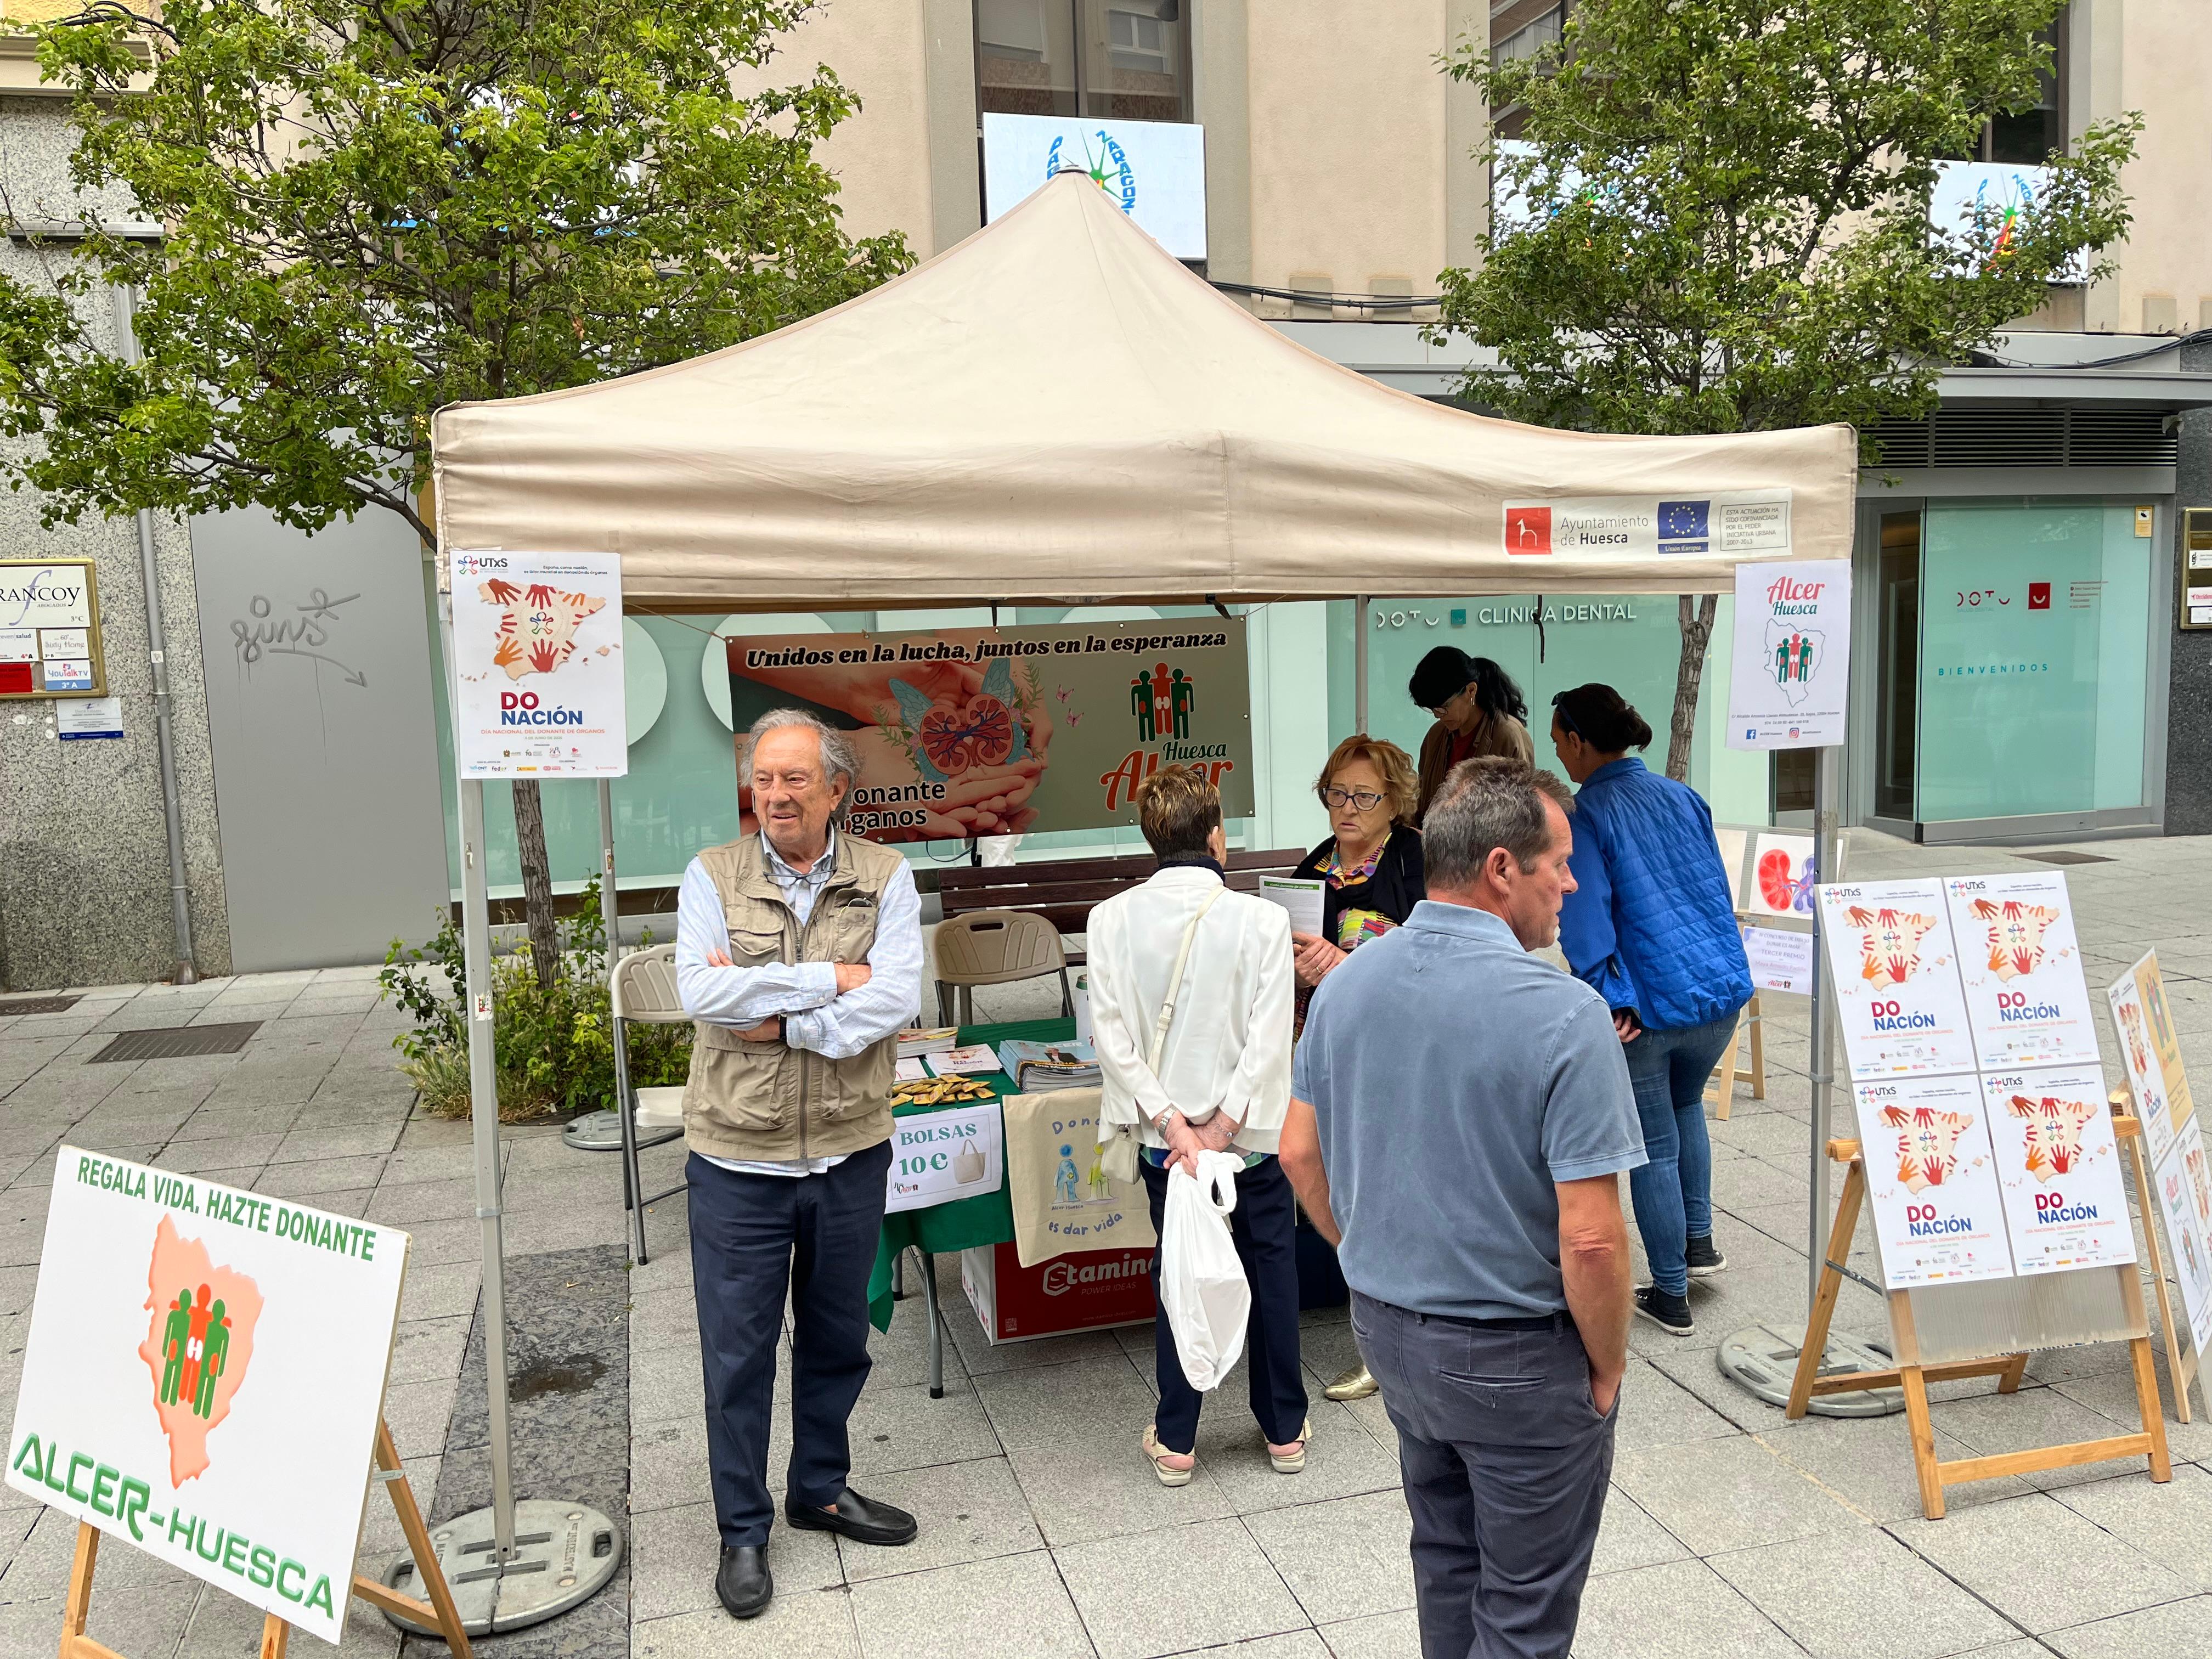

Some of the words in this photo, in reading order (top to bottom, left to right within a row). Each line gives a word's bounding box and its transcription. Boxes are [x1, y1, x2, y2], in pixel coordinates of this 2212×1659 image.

[1096, 129, 1136, 216] ZARAGOZ
[1560, 515, 1649, 533] Ayuntamiento
[1560, 533, 1575, 546] de
[1580, 532, 1628, 545] Huesca
[479, 558, 508, 567] UTxS
[1767, 576, 1825, 604] Alcer
[1564, 603, 1637, 621] DENTAL
[1773, 601, 1818, 616] Huesca
[747, 646, 834, 668] Unidos
[838, 649, 867, 664] en
[871, 644, 895, 662] la
[900, 641, 970, 661] lucha,
[973, 639, 1049, 663] juntos
[1054, 639, 1081, 654] en
[1085, 635, 1107, 652] la
[1111, 632, 1227, 655] esperanza
[1938, 663, 2048, 676] BIENVENIDOS
[501, 691, 539, 710] DO
[501, 705, 583, 725] NACIÓN
[1163, 741, 1227, 761] Huesca
[852, 781, 946, 805] onante
[838, 809, 927, 836] rganos
[1840, 888, 1861, 897] UTxS
[1965, 881, 1986, 890] UTxS
[1871, 1001, 1900, 1017] DO
[1997, 991, 2026, 1008] DO
[1874, 1011, 1936, 1031] NACIÓN
[2000, 1002, 2060, 1022] NACIÓN
[2002, 1077, 2023, 1086] UTxS
[1875, 1087, 1896, 1096] UTxS
[900, 1123, 977, 1146] BOLSAS
[77, 1155, 146, 1200] REGALA
[153, 1177, 200, 1214] VIDA.
[206, 1189, 272, 1233] HAZTE
[275, 1207, 377, 1262] DONANTE
[2035, 1192, 2063, 1210] DO
[1906, 1204, 1936, 1222] DO
[2038, 1202, 2098, 1224] NACIÓN
[1048, 1221, 1059, 1233] es
[1063, 1222, 1089, 1235] dar
[1093, 1213, 1123, 1233] vida
[1909, 1215, 1972, 1236] NACIÓN
[1081, 1285, 1111, 1295] POWER
[1113, 1281, 1137, 1291] IDEAS
[13, 1431, 335, 1621] ALCER-HUESCA
